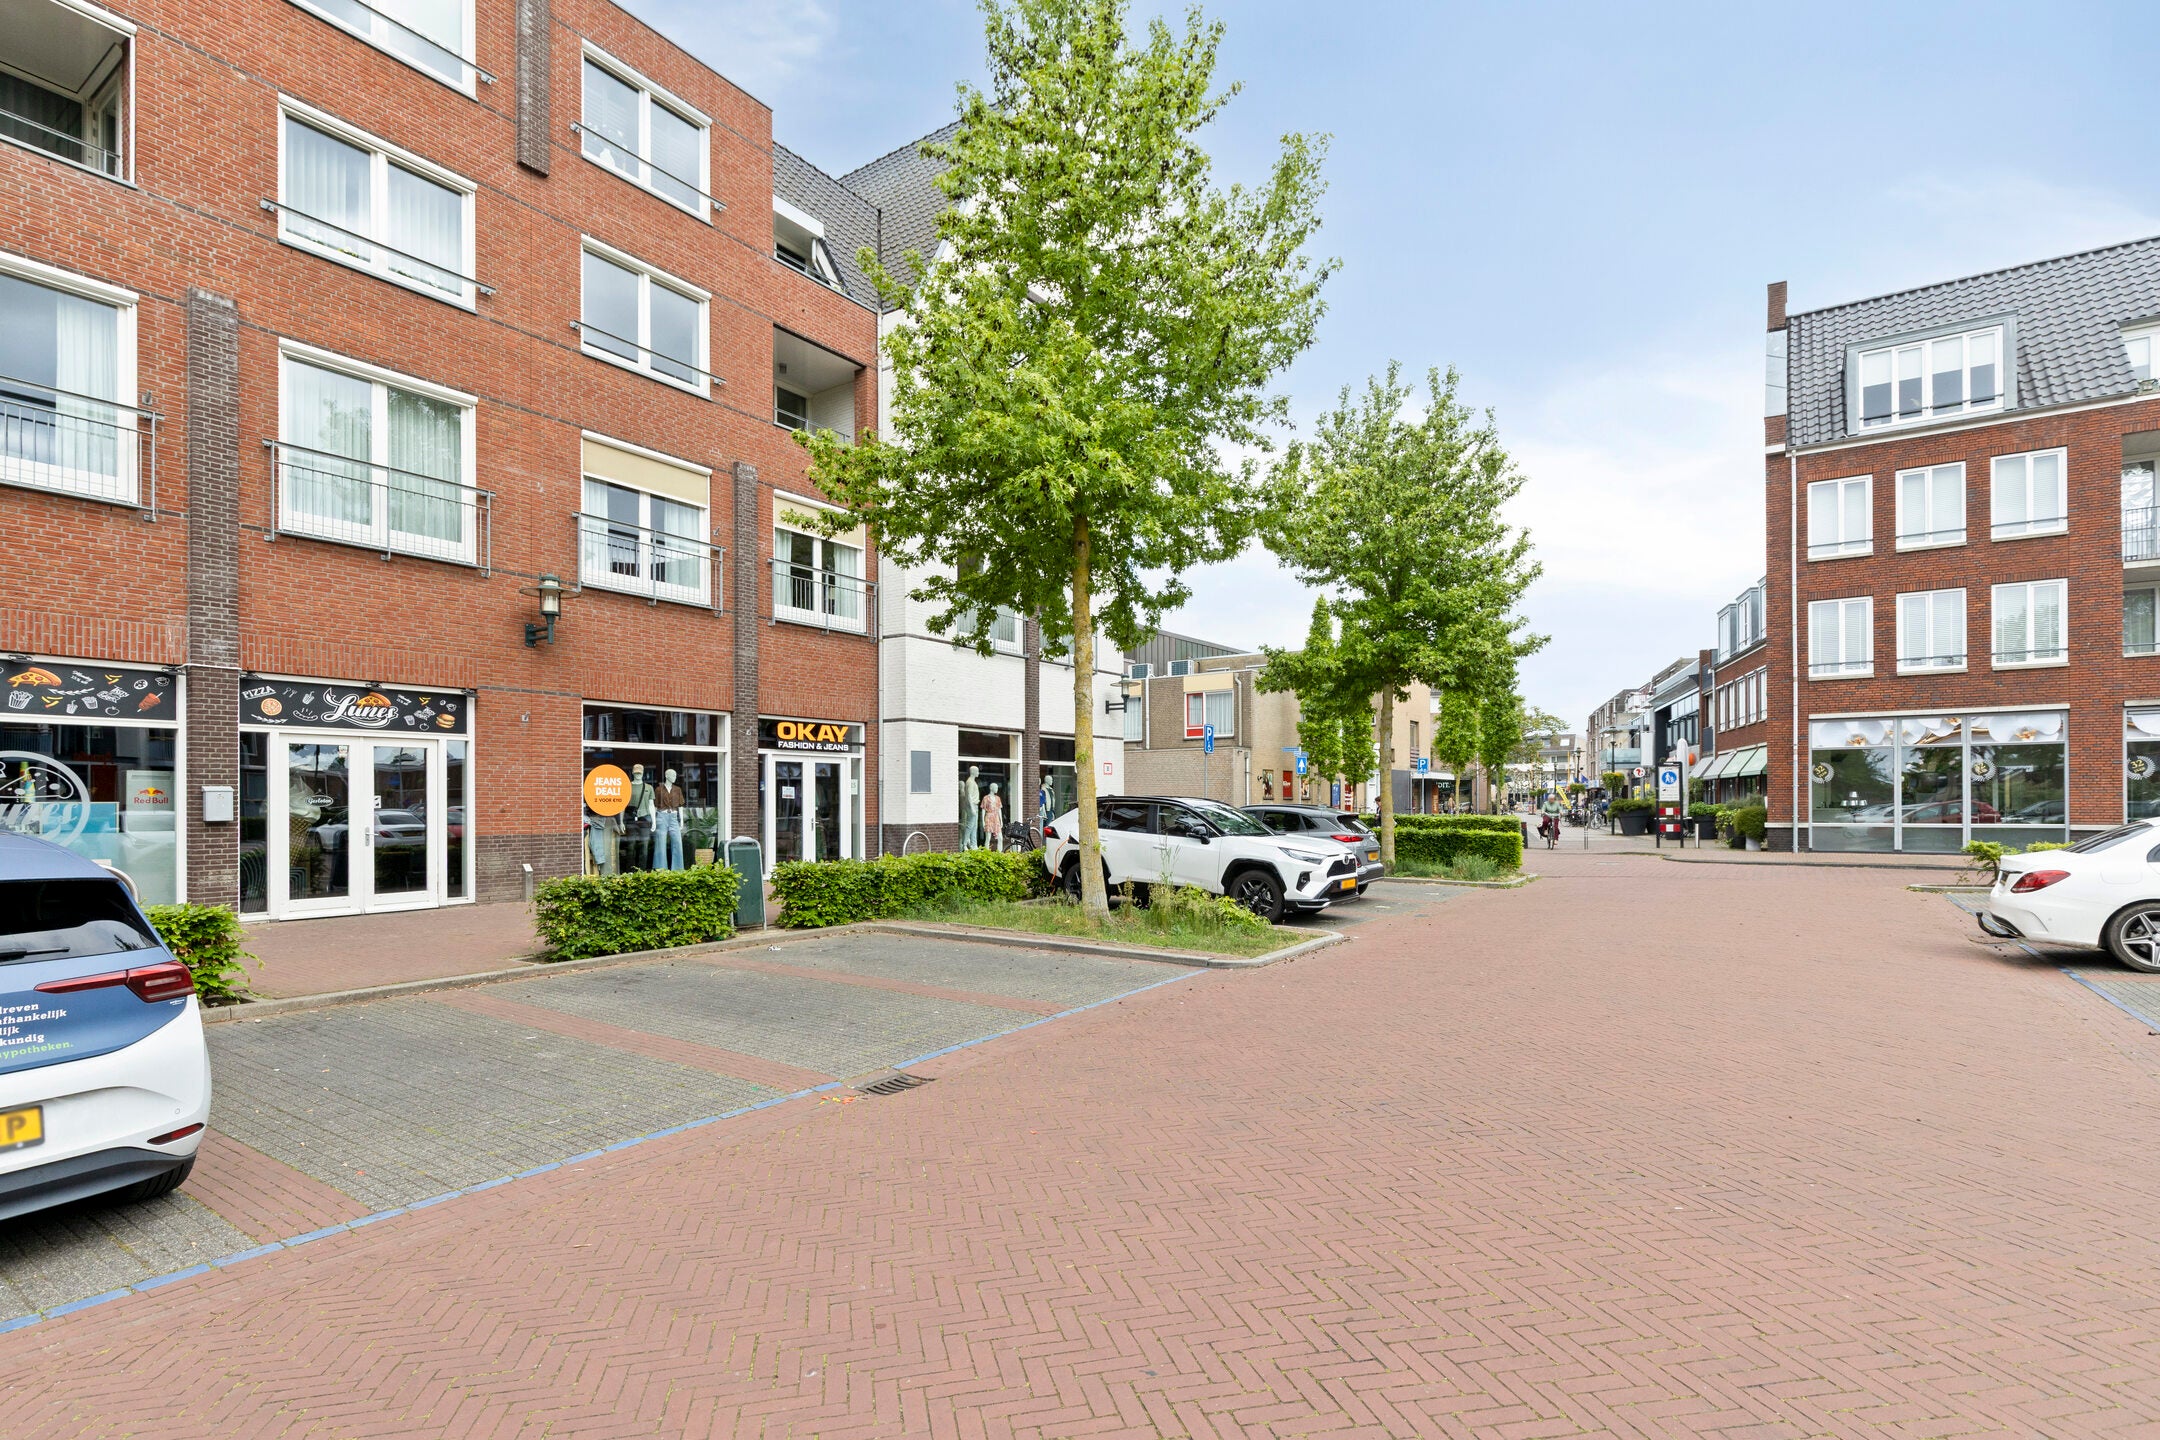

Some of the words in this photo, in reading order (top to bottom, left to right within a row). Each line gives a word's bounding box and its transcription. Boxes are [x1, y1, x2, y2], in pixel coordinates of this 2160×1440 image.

[241, 685, 275, 699] PIZZA
[320, 688, 399, 728] Lunes
[777, 722, 849, 743] OKAY
[1206, 727, 1213, 741] P
[778, 741, 815, 750] FASHION
[1419, 760, 1427, 768] P
[2130, 759, 2145, 769] 32
[594, 777, 622, 786] JEANS
[596, 787, 621, 796] DEAL!
[152, 796, 169, 804] Bull
[0, 1042, 75, 1059] ypotheken.
